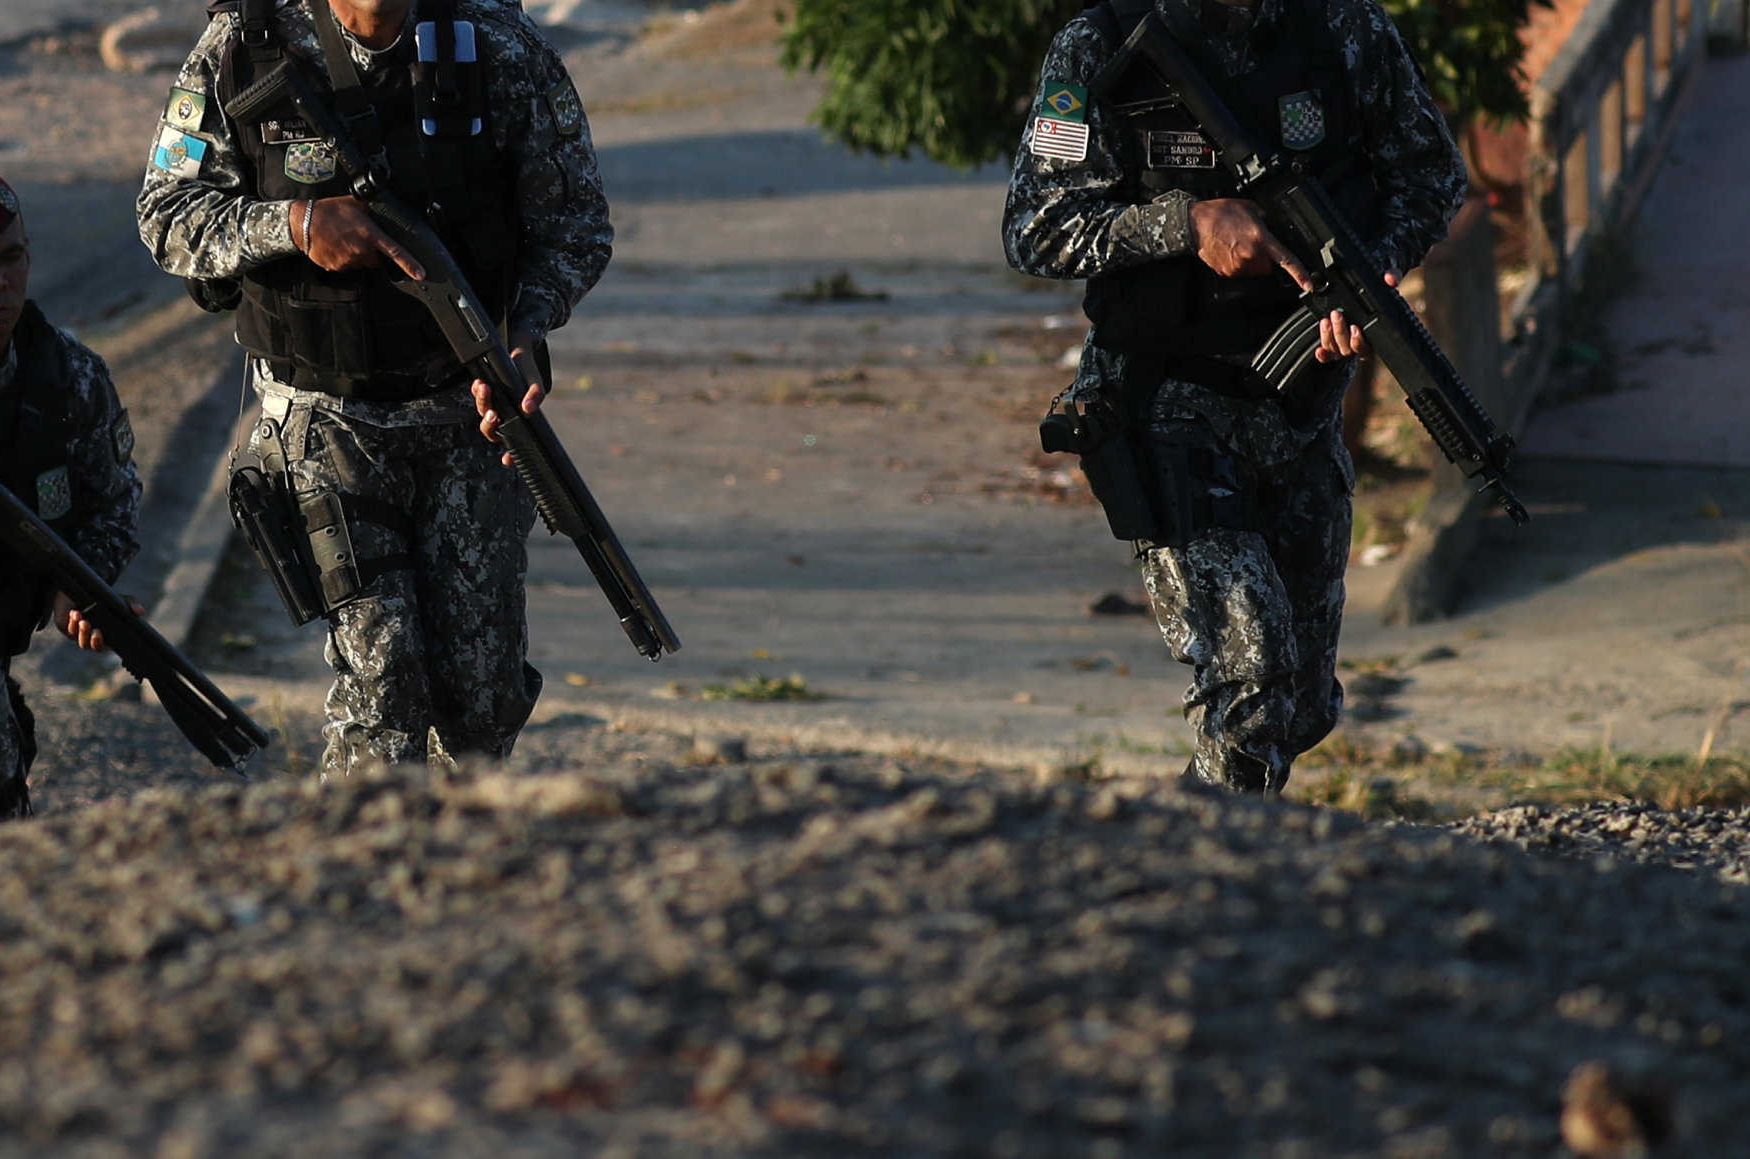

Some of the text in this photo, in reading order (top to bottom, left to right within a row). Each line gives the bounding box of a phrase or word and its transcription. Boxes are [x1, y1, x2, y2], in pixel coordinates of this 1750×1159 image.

[282, 131, 293, 140] PM
[1170, 145, 1202, 155] SANDRO
[1185, 156, 1199, 166] SP
